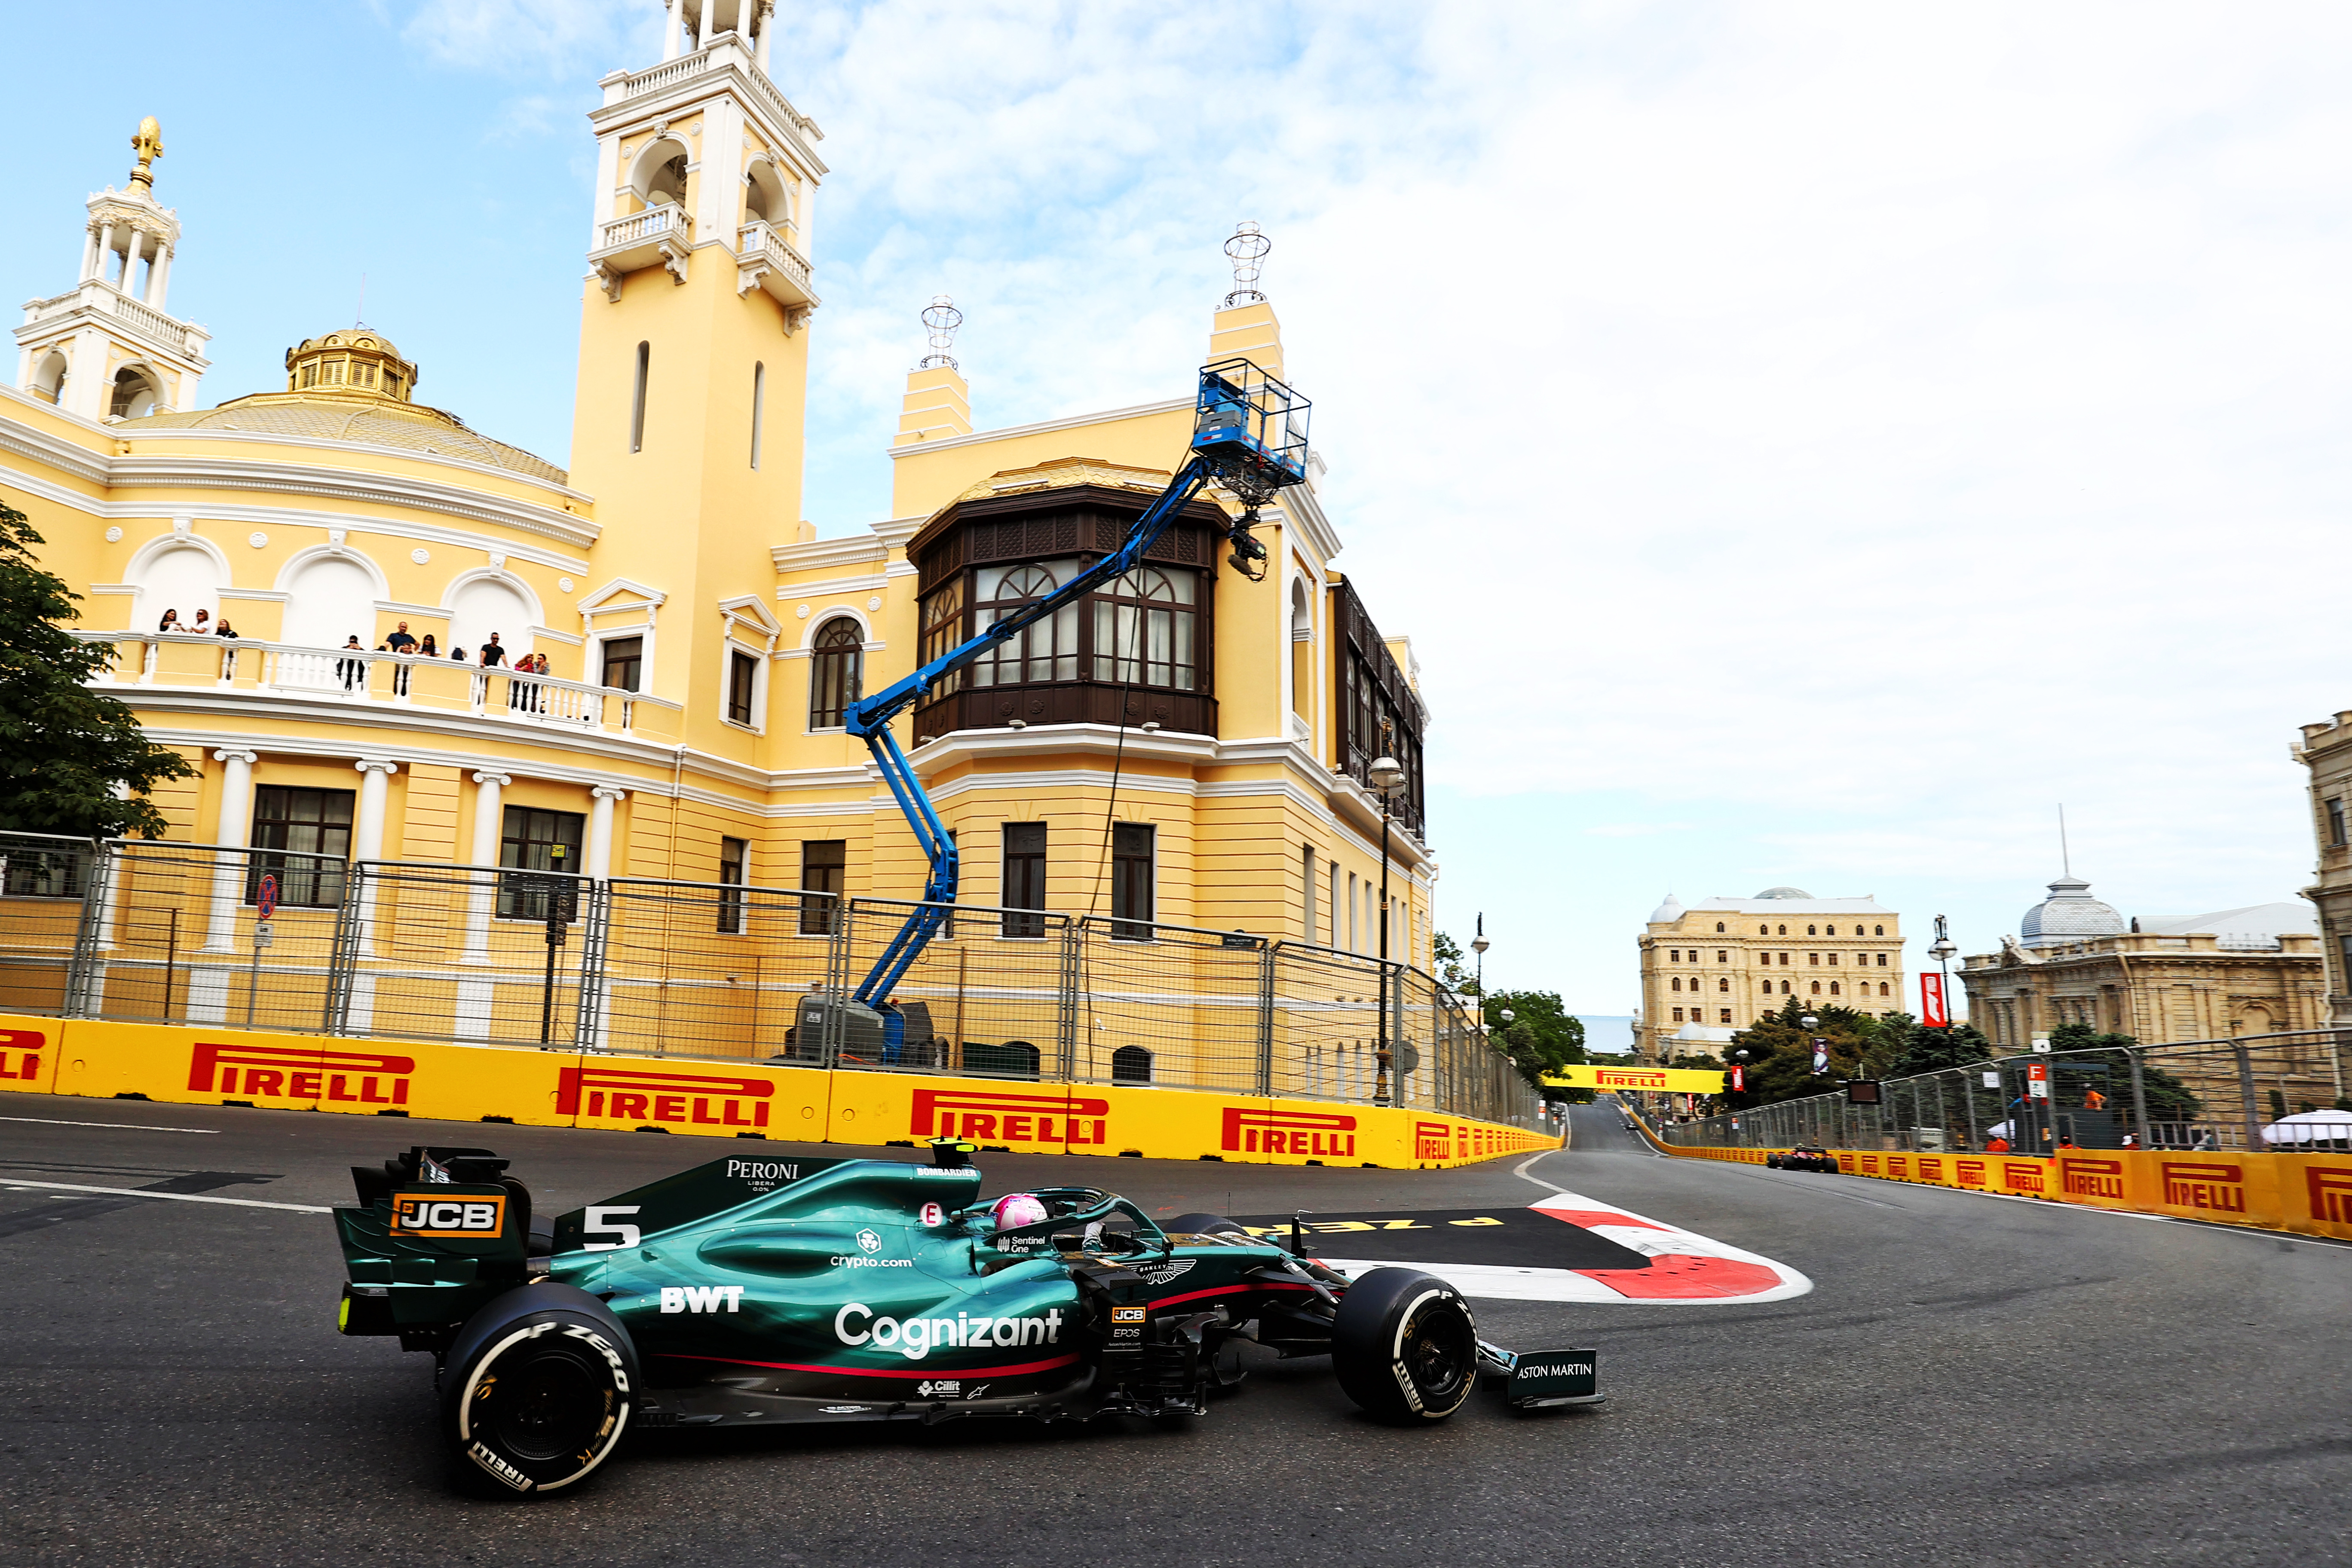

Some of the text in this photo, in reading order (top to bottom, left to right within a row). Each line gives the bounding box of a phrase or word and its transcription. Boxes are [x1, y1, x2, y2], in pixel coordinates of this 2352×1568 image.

[188, 1043, 415, 1104] PIRELLI
[1596, 1070, 1666, 1087] PIRELLI
[2030, 1066, 2041, 1078] F
[555, 1067, 775, 1127] PIRELLI
[910, 1089, 1109, 1144] PIRELLI
[1221, 1108, 1357, 1156] PIRELLI
[1415, 1121, 1449, 1159] PIRELLI
[726, 1160, 799, 1179] PERONI
[916, 1167, 977, 1177] BOMBARDIER
[2061, 1158, 2124, 1199] PIRELLI
[2161, 1162, 2246, 1213] PIRELLI
[401, 1203, 495, 1228] JCB
[927, 1205, 937, 1223] E
[583, 1206, 641, 1252] 5
[1011, 1236, 1045, 1244] Sentinel
[830, 1256, 912, 1268] crypto.com
[660, 1286, 744, 1313] BWT
[1440, 1290, 1453, 1299] P
[1115, 1310, 1143, 1320] JCB
[835, 1302, 1062, 1360] Cognizant
[1114, 1329, 1140, 1337] EPOS
[528, 1322, 630, 1392] P ZERO
[1518, 1363, 1592, 1379] ASTON MARTIN
[934, 1381, 960, 1391] Cillit
[1392, 1360, 1424, 1413] PIRELLI
[468, 1441, 533, 1492] PIRELLI
